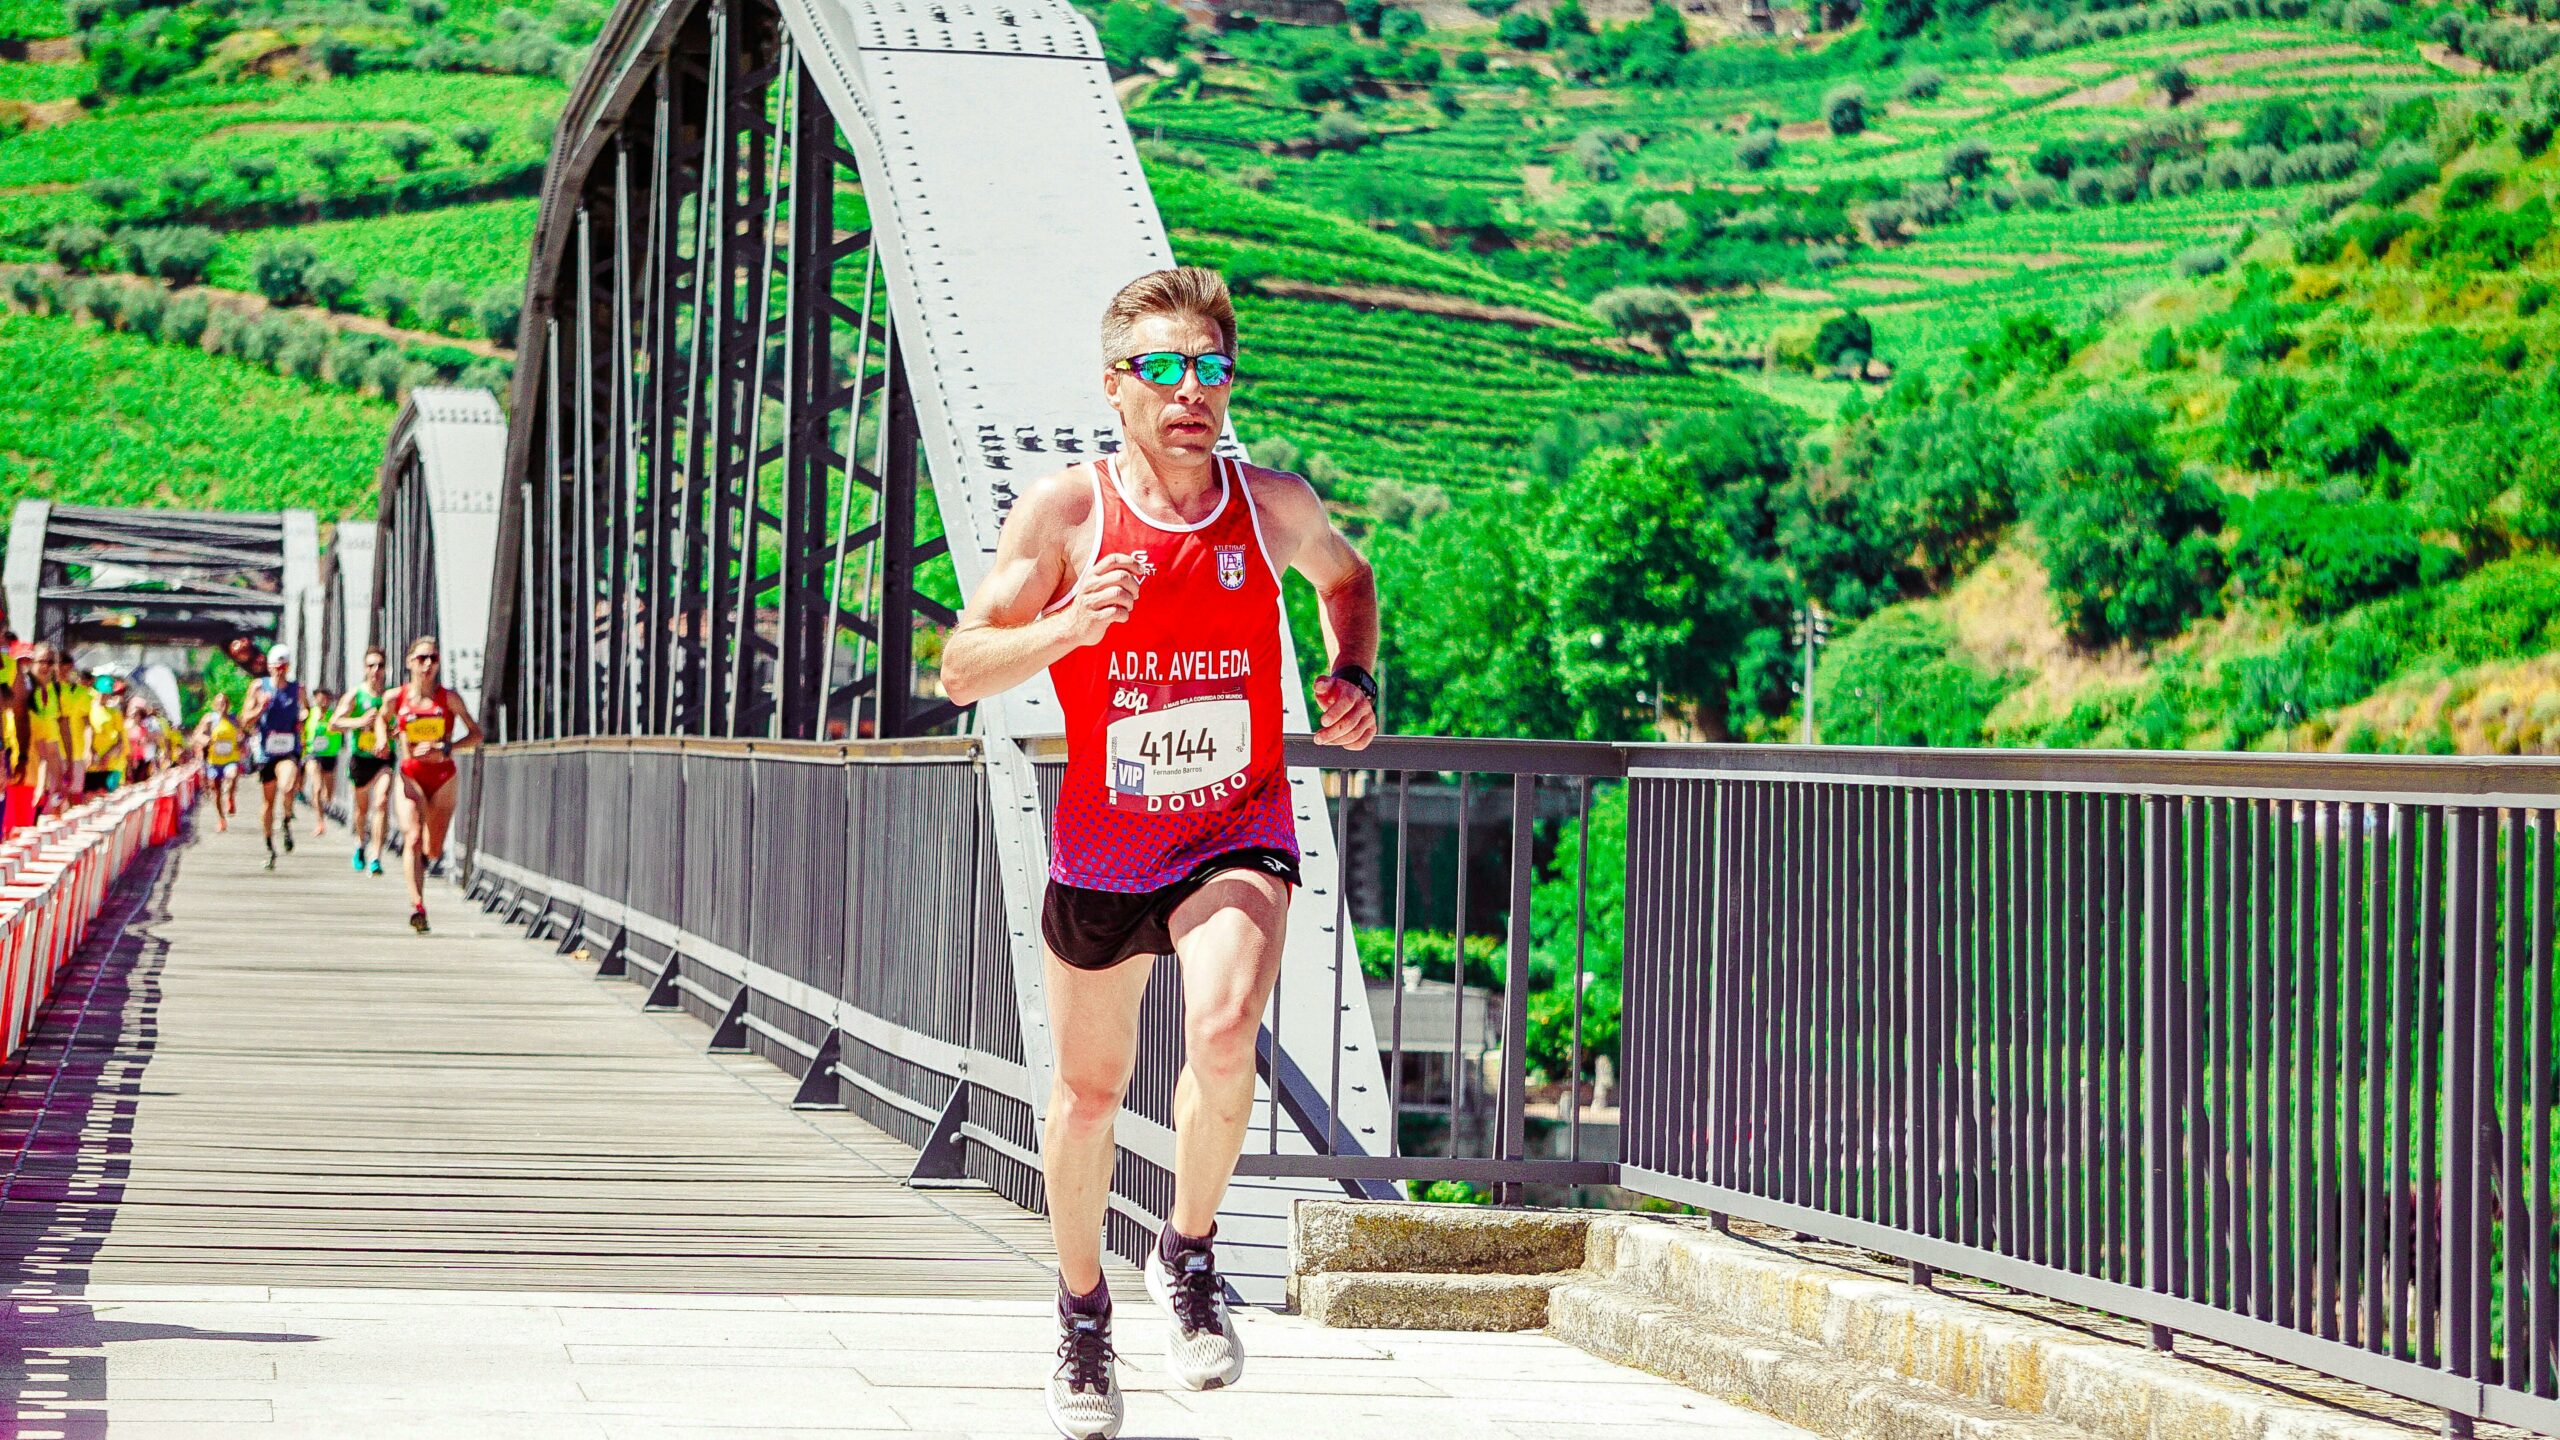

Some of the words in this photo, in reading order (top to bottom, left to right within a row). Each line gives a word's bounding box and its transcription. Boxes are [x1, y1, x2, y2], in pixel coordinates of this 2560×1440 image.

[1108, 651, 1163, 680] A.D.R.
[1168, 648, 1251, 681] AVELEDA
[1112, 686, 1149, 716] edp
[1167, 700, 1180, 709] MAIS
[1180, 697, 1194, 705] BELA
[1193, 694, 1217, 702] CORRIDA
[1139, 727, 1217, 766] 4144
[1118, 763, 1143, 788] VIP
[1153, 768, 1182, 776] Fernando
[1147, 772, 1247, 812] DOURO
